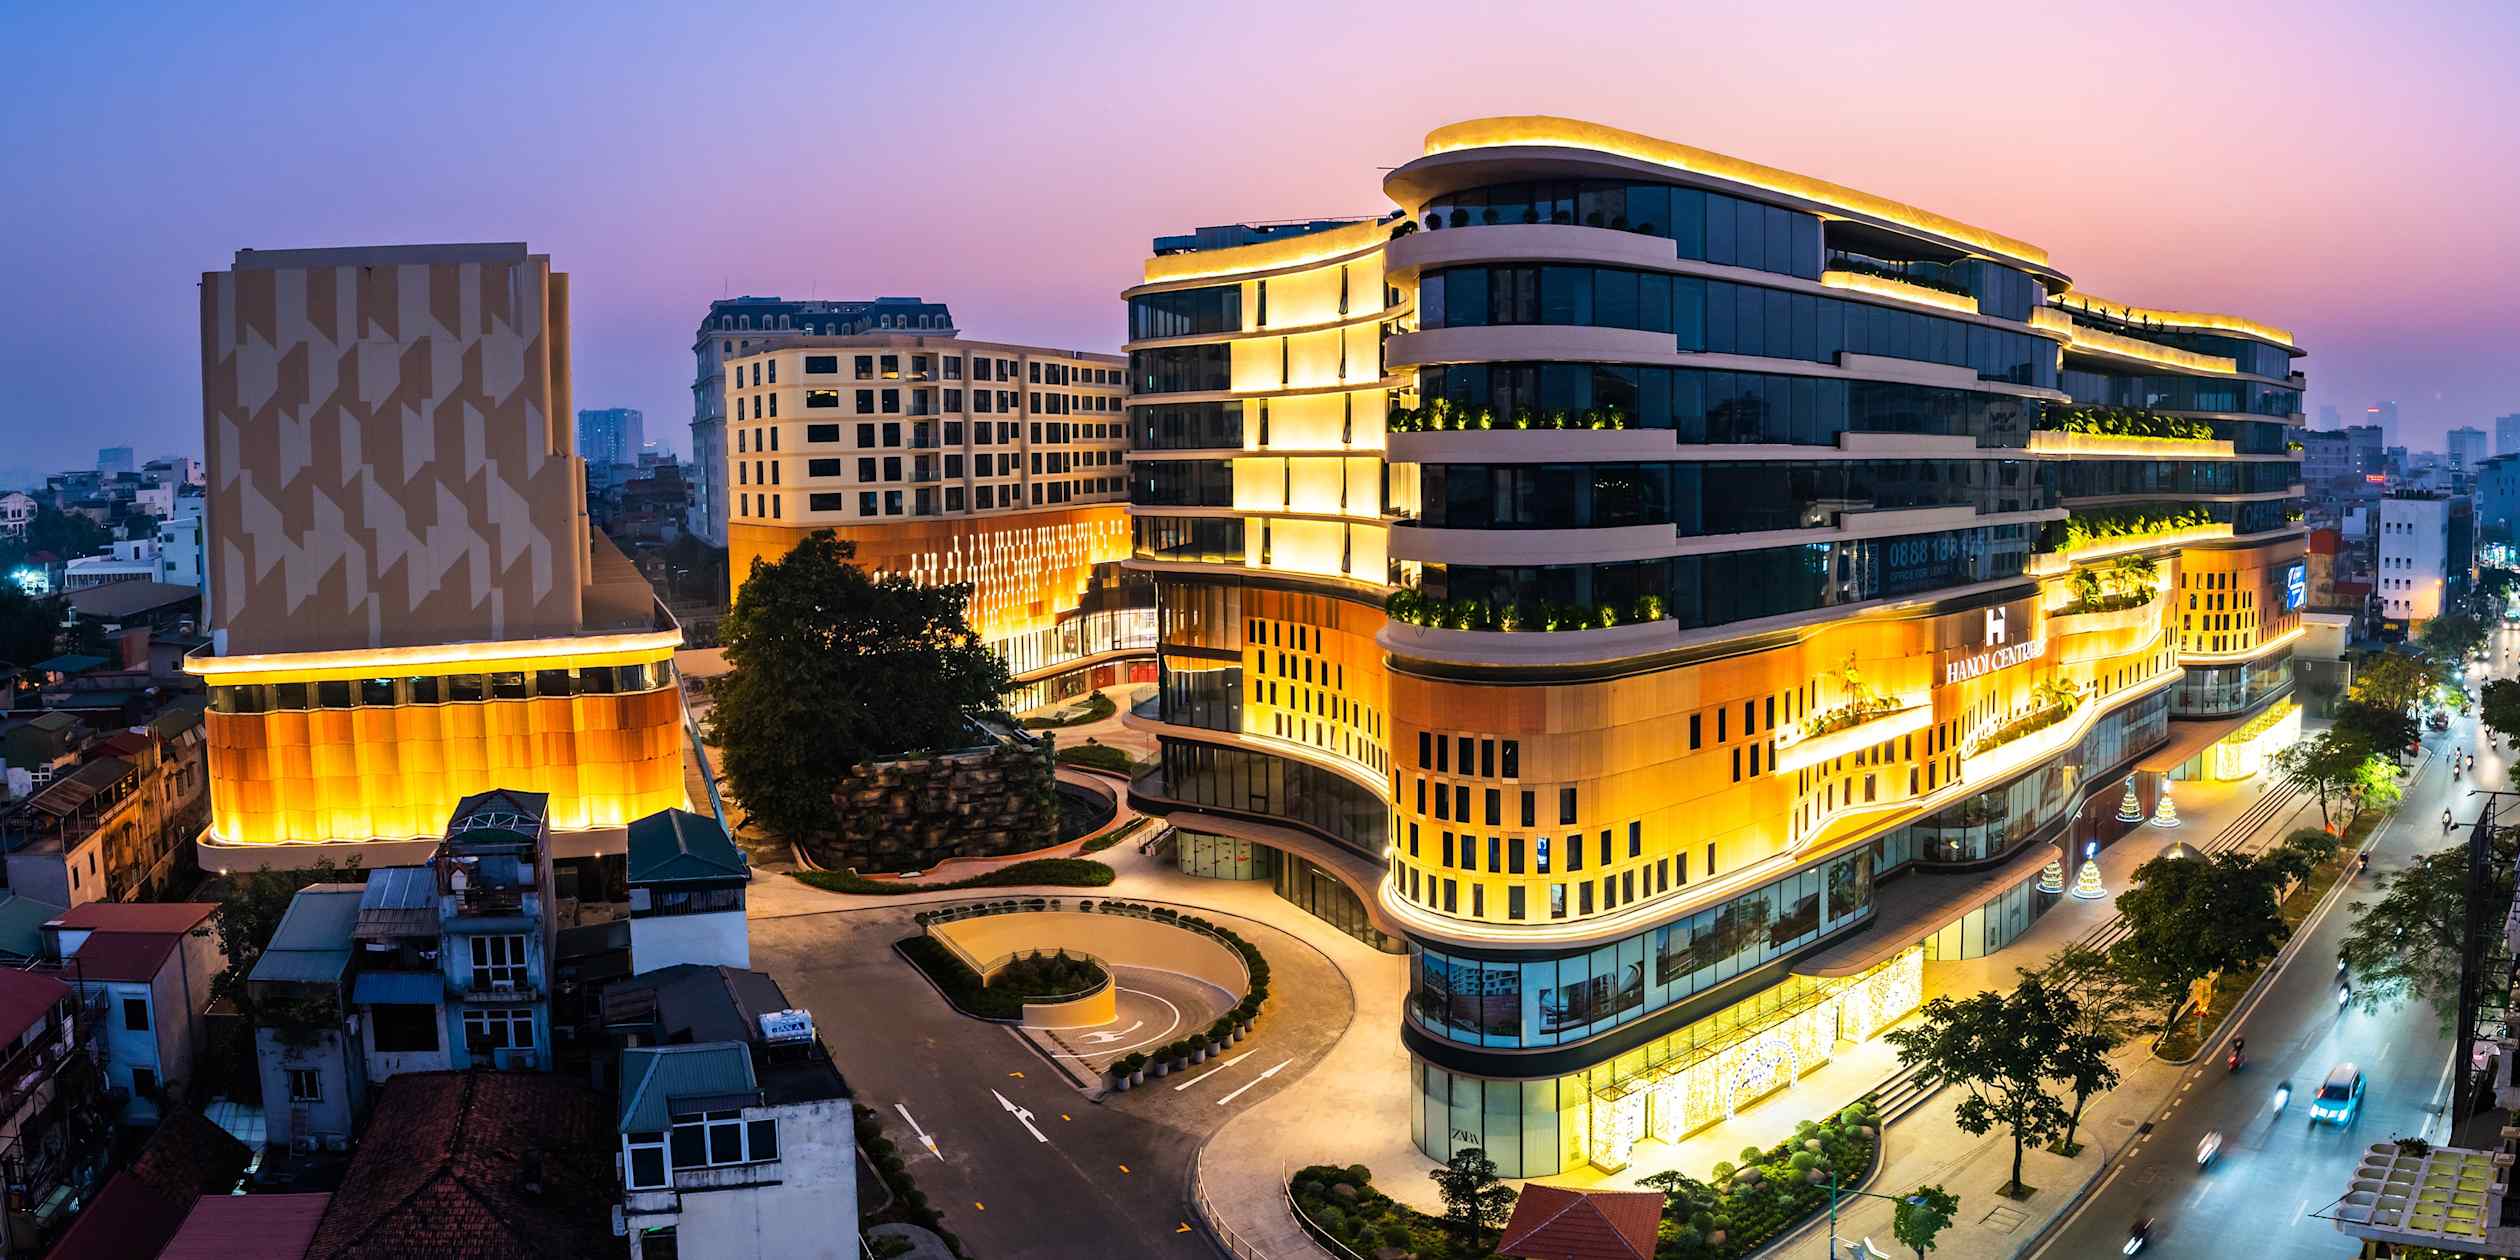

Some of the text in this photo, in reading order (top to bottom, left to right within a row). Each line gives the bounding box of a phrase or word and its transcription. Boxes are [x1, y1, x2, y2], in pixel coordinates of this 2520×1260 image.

[1889, 539, 1928, 567] 0888
[1986, 606, 2006, 646] H
[1946, 653, 1990, 685] HANOI
[1452, 1127, 1479, 1145] ZARA
